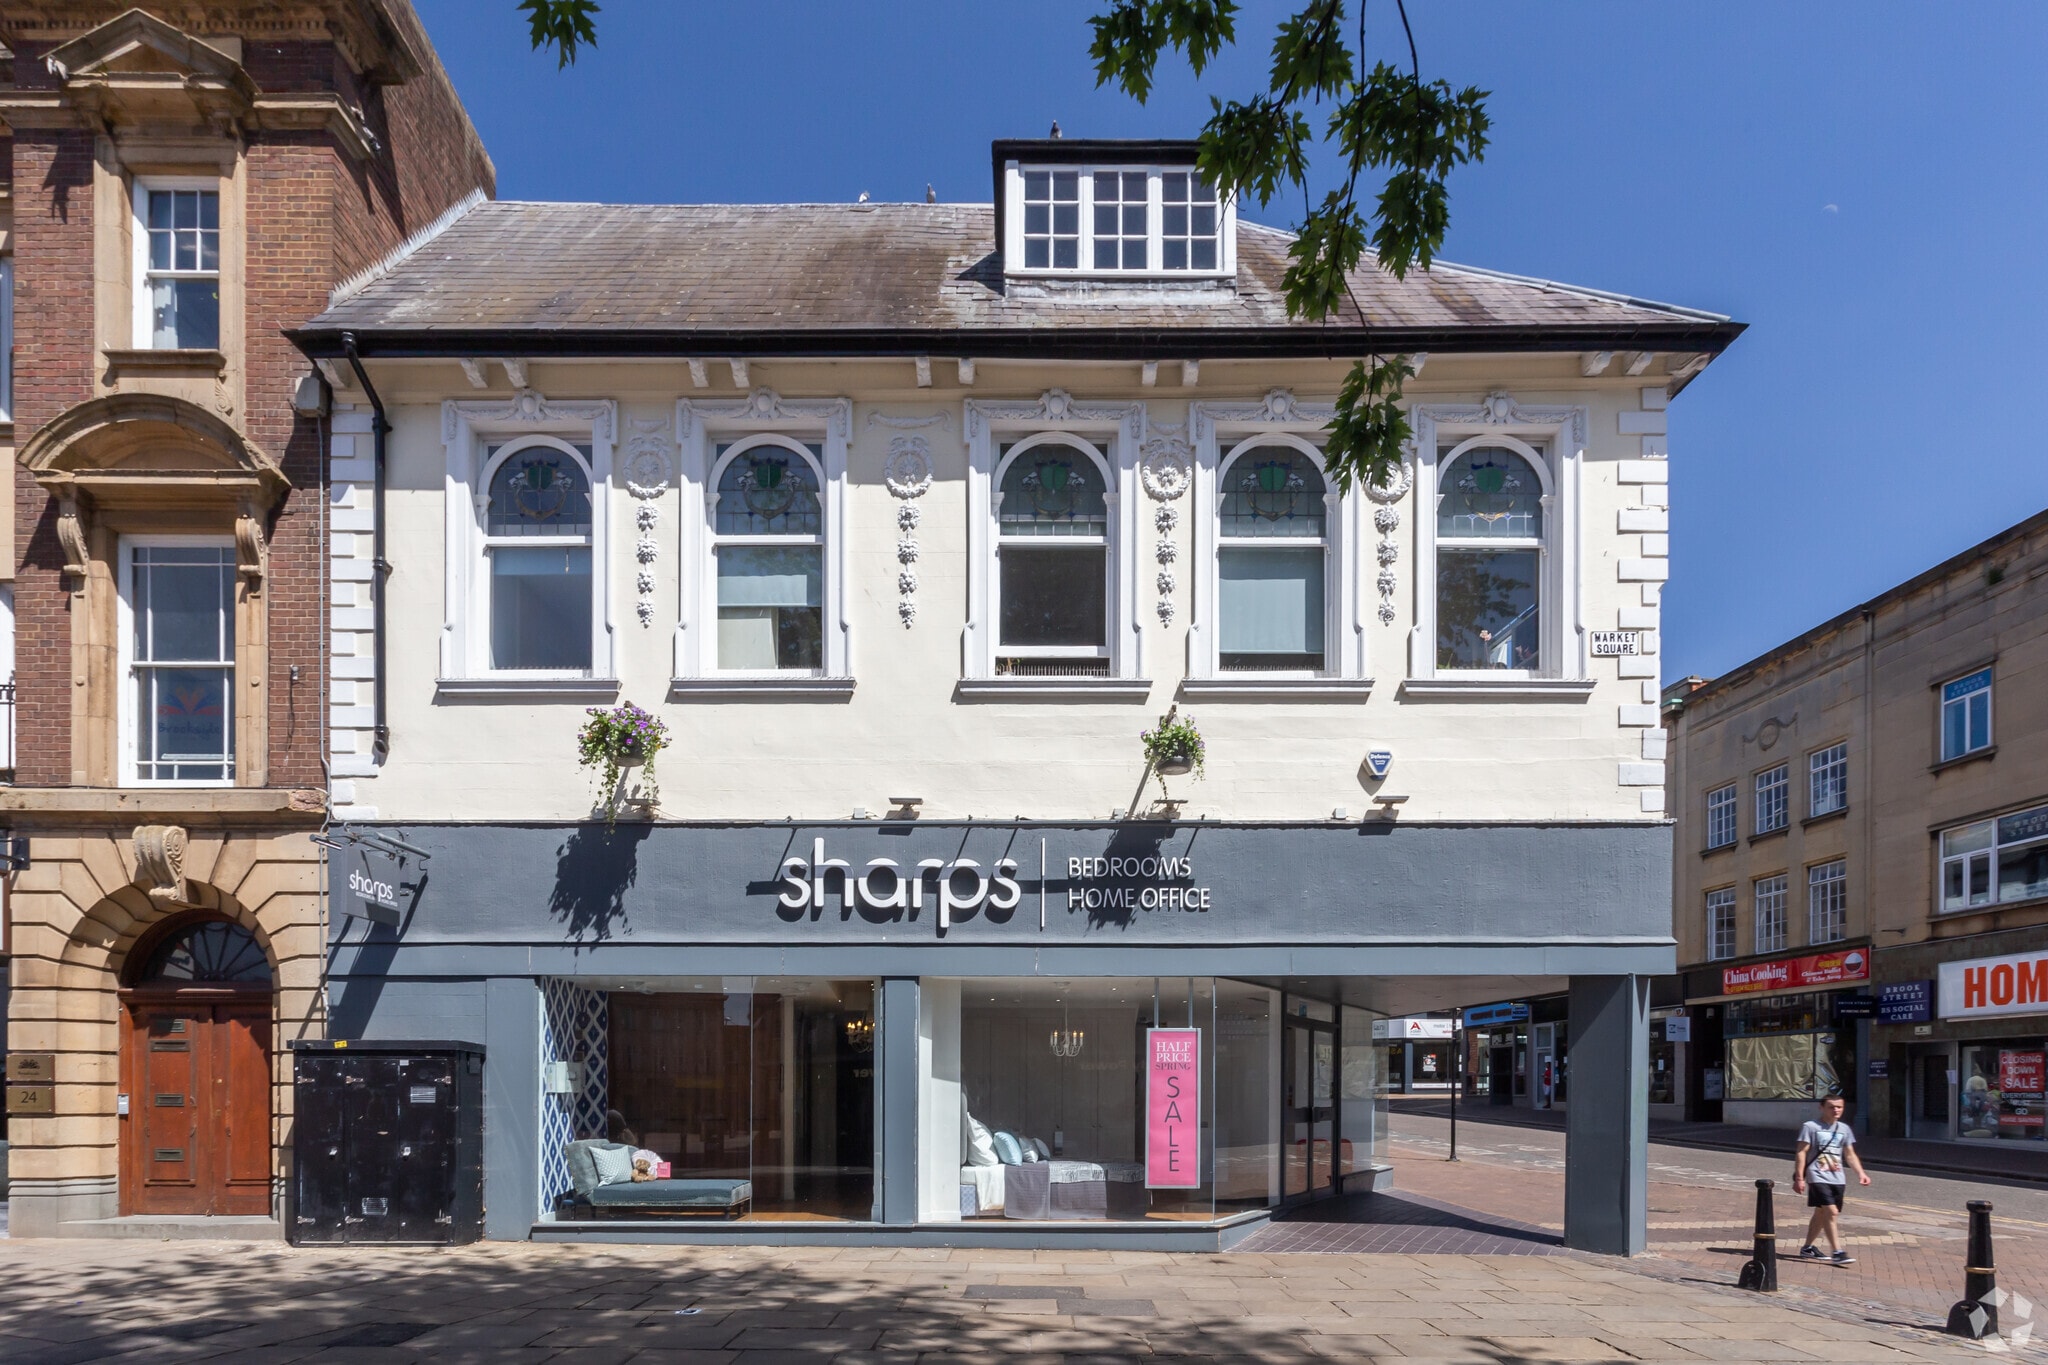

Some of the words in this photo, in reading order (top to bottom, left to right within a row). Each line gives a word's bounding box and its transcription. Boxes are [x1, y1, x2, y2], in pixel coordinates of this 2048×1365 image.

[1594, 633, 1636, 643] MARKET
[1596, 643, 1634, 654] SQUARE
[1068, 856, 1193, 878] BEDROOMS
[349, 869, 393, 902] sharps
[778, 837, 1022, 929] sharps
[1068, 887, 1136, 909] HOME
[1140, 887, 1211, 909] OFFICE
[1725, 970, 1750, 985] China
[1750, 964, 1788, 982] Cooking
[1885, 984, 1921, 994] BROOK
[1964, 959, 2048, 1009] HOM
[1882, 991, 1924, 1002] STREET
[1892, 1004, 1925, 1013] SOCIAL
[1890, 1012, 1914, 1021] CARE
[1156, 1041, 1192, 1052] HALF
[1156, 1052, 1191, 1063] PRICE
[2001, 1055, 2042, 1064] CLOSING
[1155, 1062, 1191, 1071] SPRING
[2007, 1066, 2036, 1075] DOWN
[2005, 1077, 2039, 1089] SALE
[20, 1090, 38, 1104] 24
[1164, 1076, 1182, 1172] SALE
